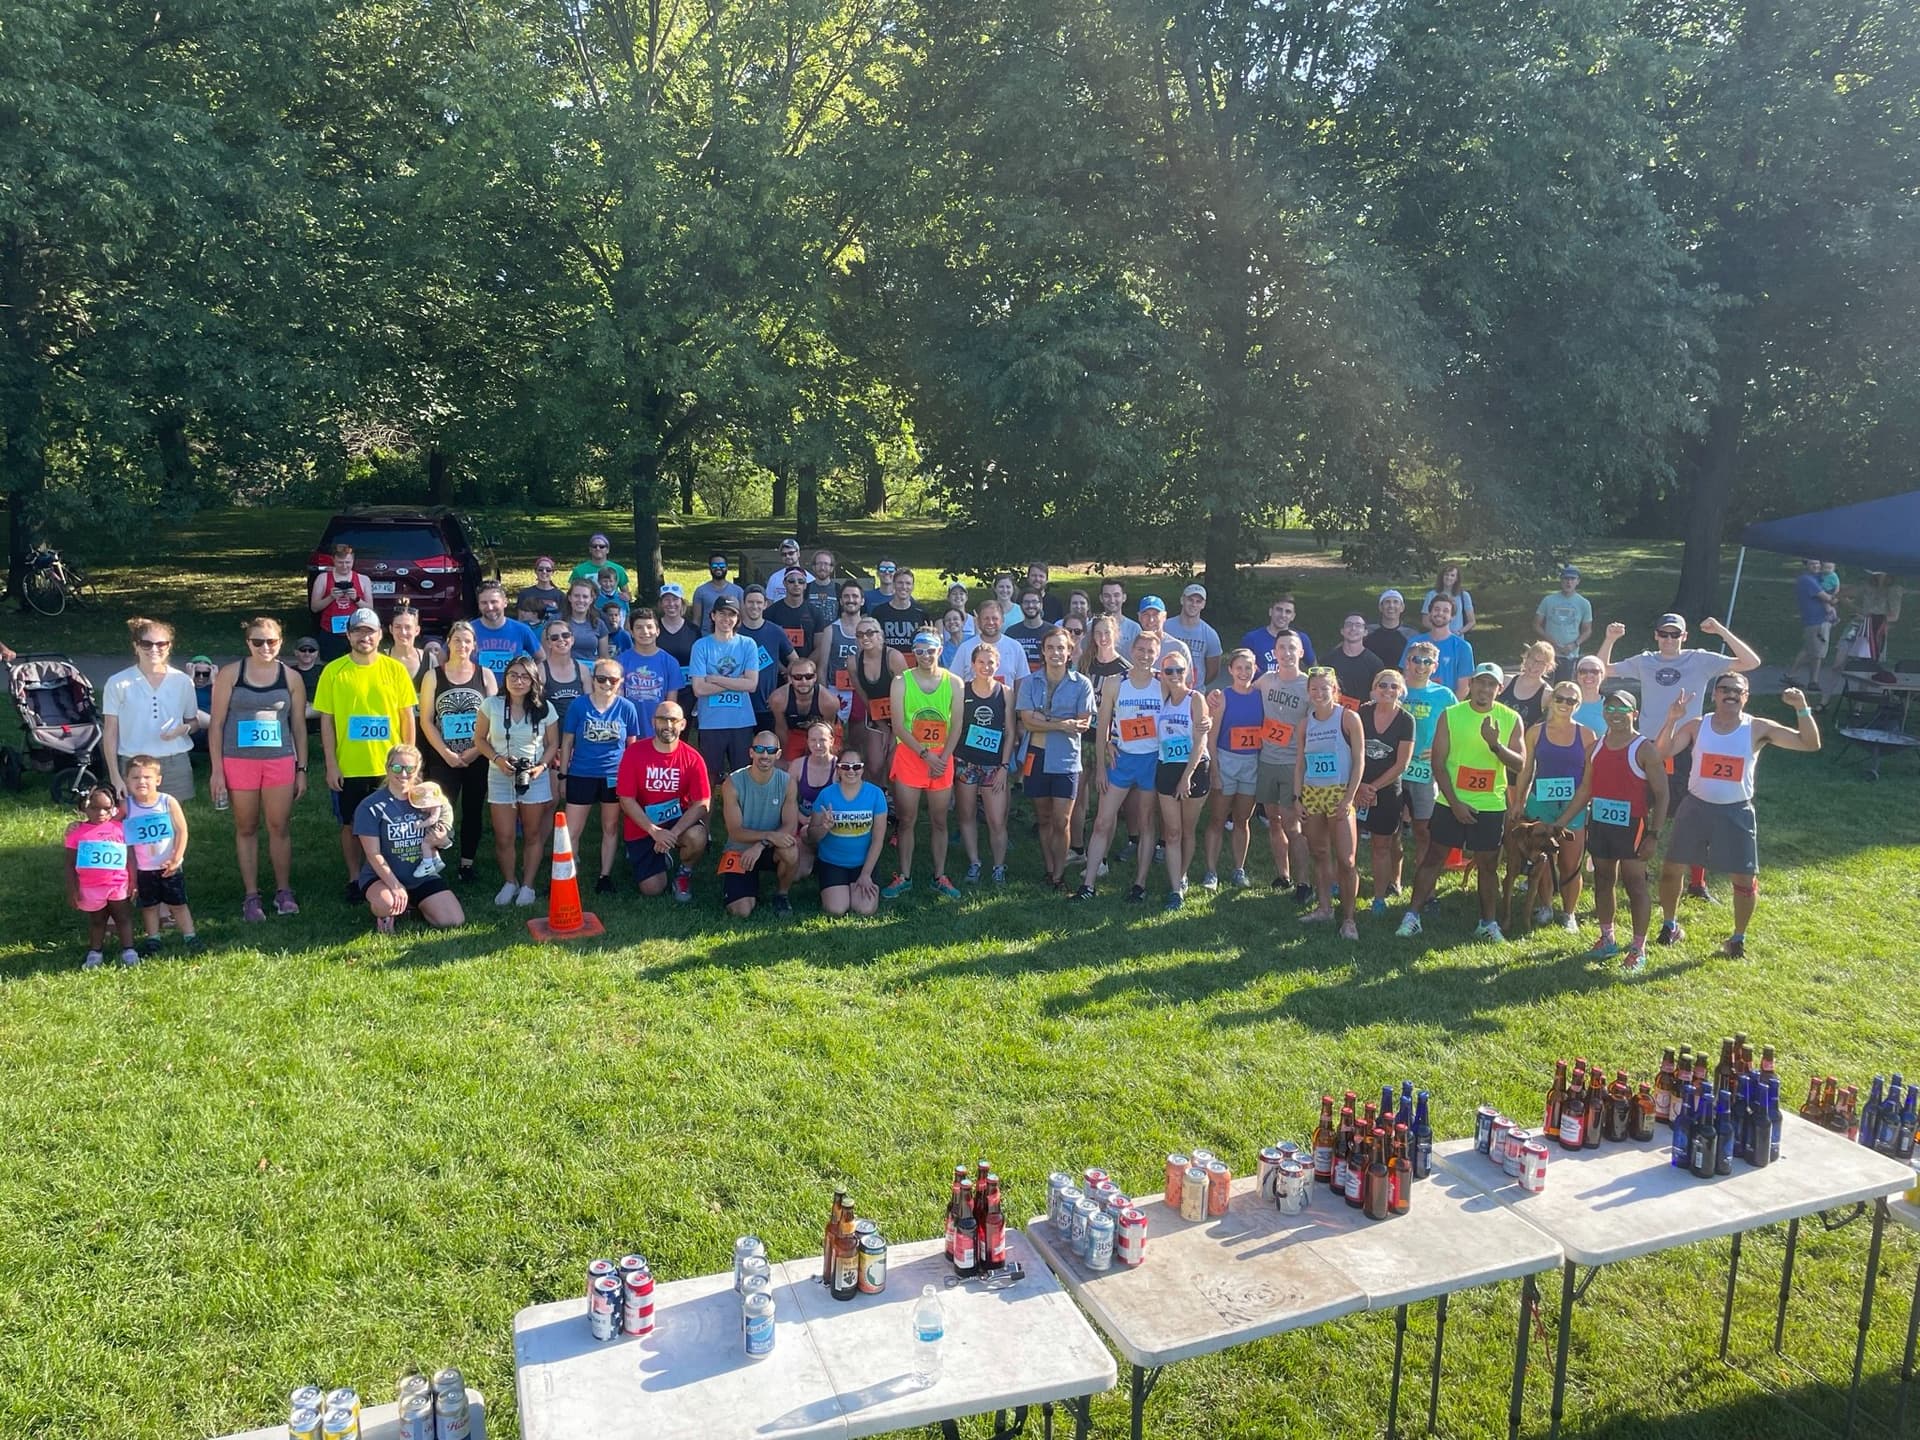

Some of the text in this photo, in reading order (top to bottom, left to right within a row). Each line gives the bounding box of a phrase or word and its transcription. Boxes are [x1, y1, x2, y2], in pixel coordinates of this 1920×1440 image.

[884, 621, 915, 638] RUN
[718, 693, 741, 704] 209
[1118, 698, 1161, 707] MARQUETTE
[1267, 688, 1300, 709] BUCKS
[251, 728, 279, 742] 301
[360, 725, 389, 738] 200
[922, 728, 940, 741] 26
[1132, 724, 1150, 738] 11
[1268, 727, 1285, 742] 22
[975, 735, 999, 749] 205
[1240, 735, 1256, 747] 21
[1167, 744, 1190, 758] 201
[646, 767, 681, 781] MKE
[1314, 761, 1337, 773] 201
[1406, 765, 1431, 779] 203
[1712, 763, 1734, 777] 23
[645, 779, 680, 791] LOVE
[1468, 776, 1487, 789] 28
[1547, 786, 1573, 798] 203
[658, 804, 679, 822] 200
[1601, 808, 1628, 822] 203
[137, 823, 170, 840] 302
[90, 851, 123, 866] 302
[727, 858, 735, 870] 9
